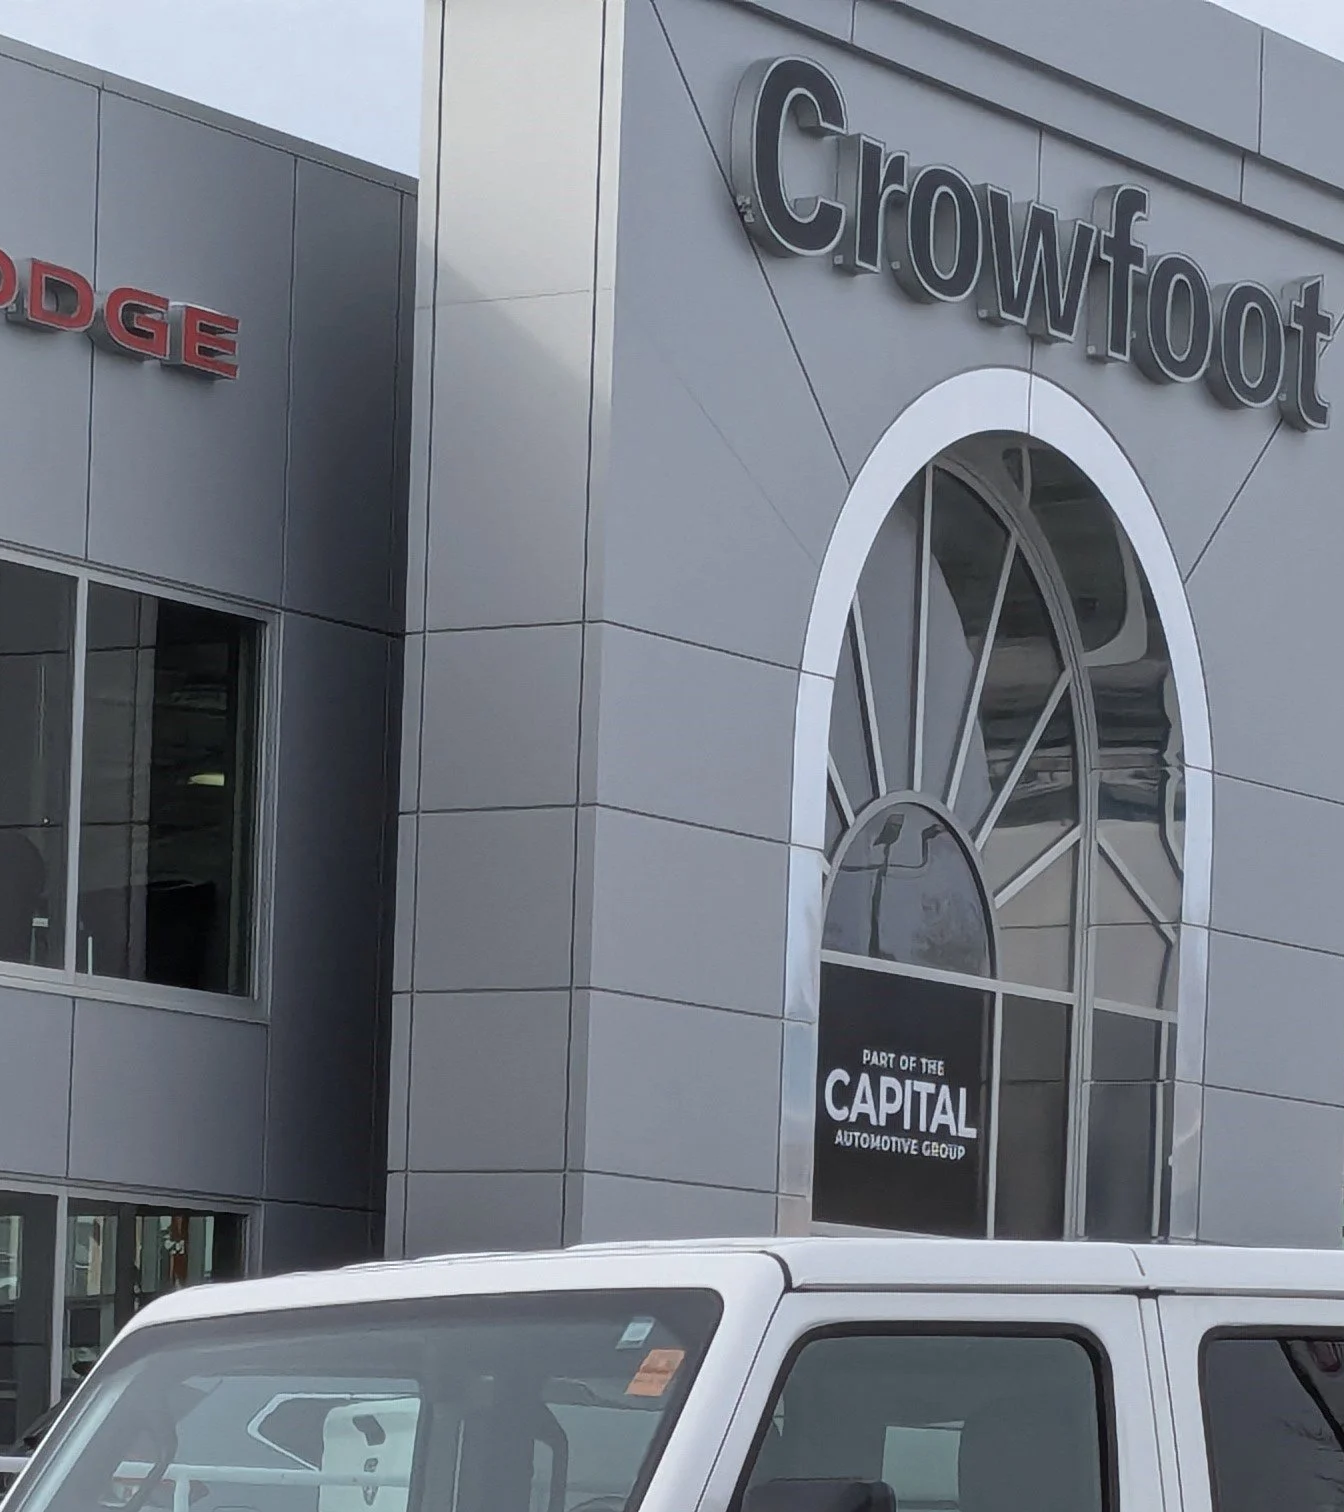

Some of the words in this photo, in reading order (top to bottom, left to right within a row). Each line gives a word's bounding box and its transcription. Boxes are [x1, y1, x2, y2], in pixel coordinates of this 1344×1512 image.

[754, 54, 1335, 431] Crowfoot
[862, 1049, 895, 1069] PART
[899, 1054, 917, 1072] OF
[920, 1057, 945, 1076] THE
[824, 1068, 978, 1139] CAPITAL
[834, 1129, 919, 1155] AUTOMOTIVE
[921, 1140, 966, 1161] GROUP
